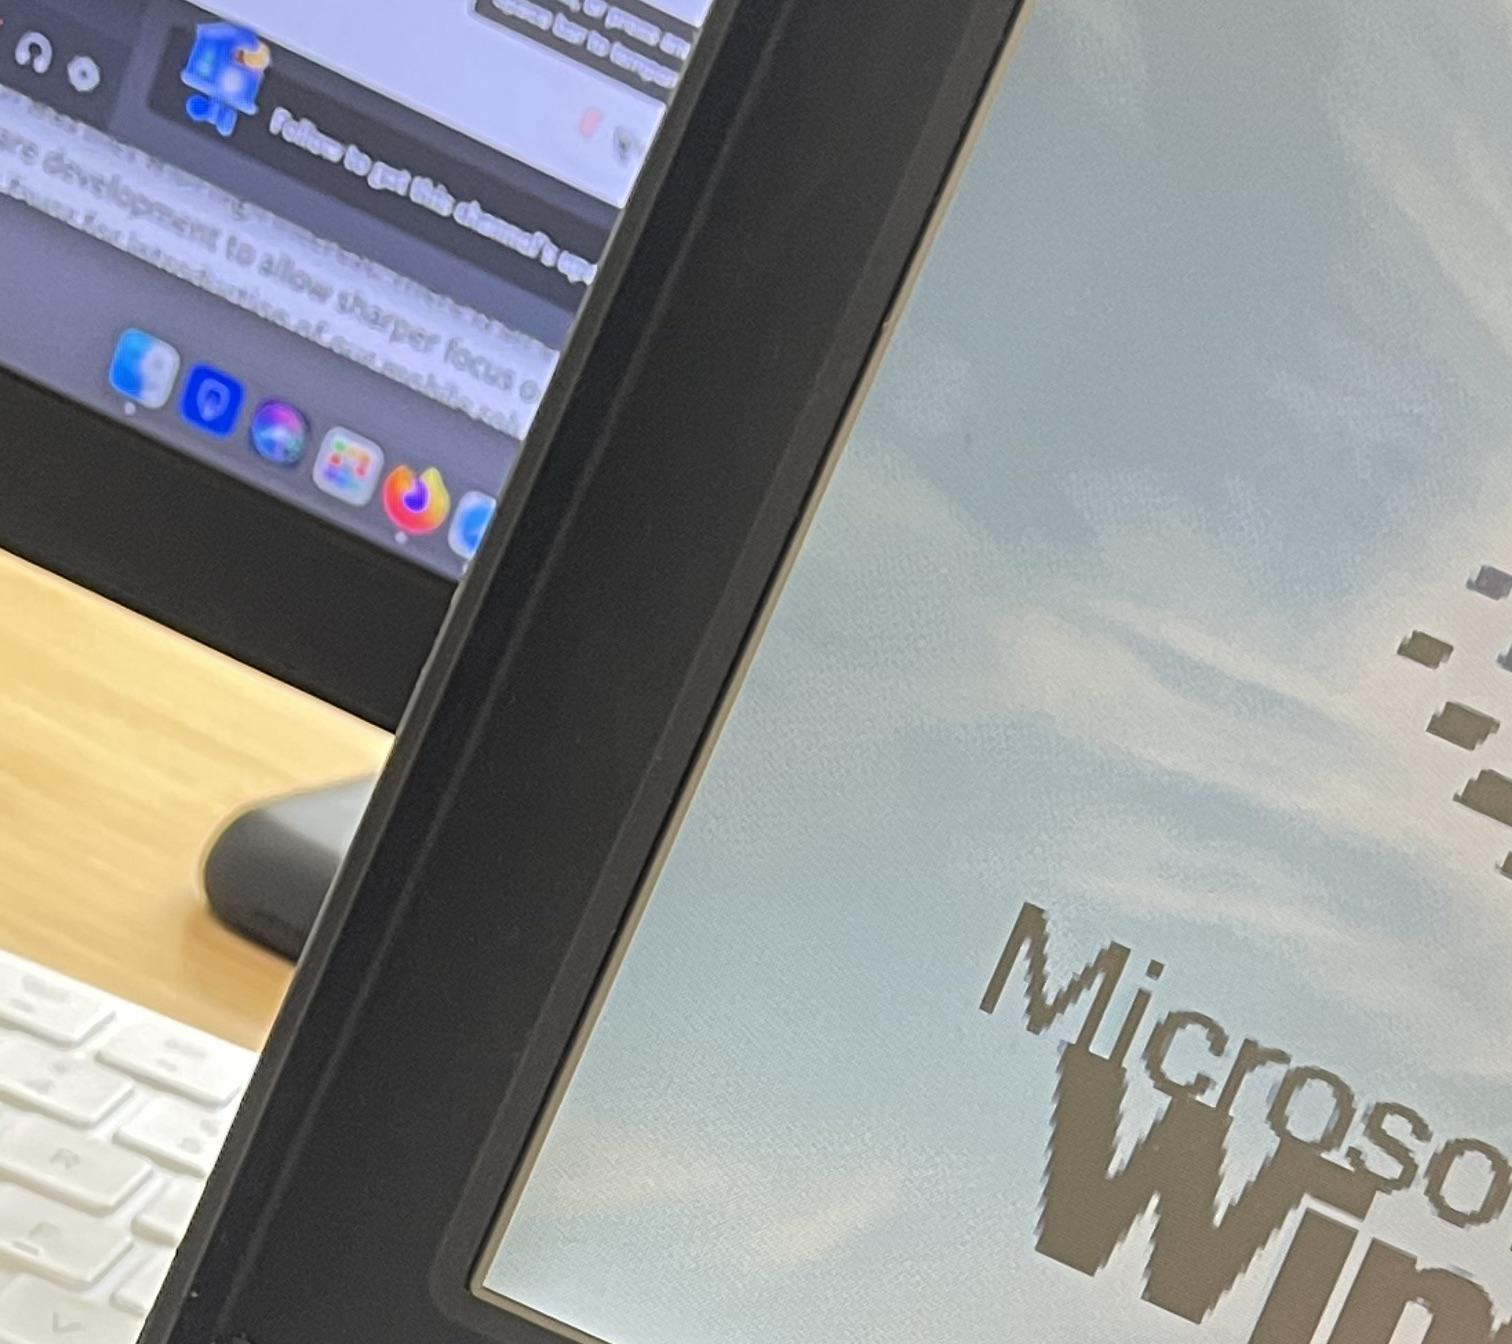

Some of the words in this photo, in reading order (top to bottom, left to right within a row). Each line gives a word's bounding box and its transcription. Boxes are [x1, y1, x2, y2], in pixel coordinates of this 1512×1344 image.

[42, 150, 221, 254] development
[225, 234, 257, 268] to
[256, 250, 334, 305] allow
[337, 290, 440, 353] sharper
[444, 336, 516, 392] focus
